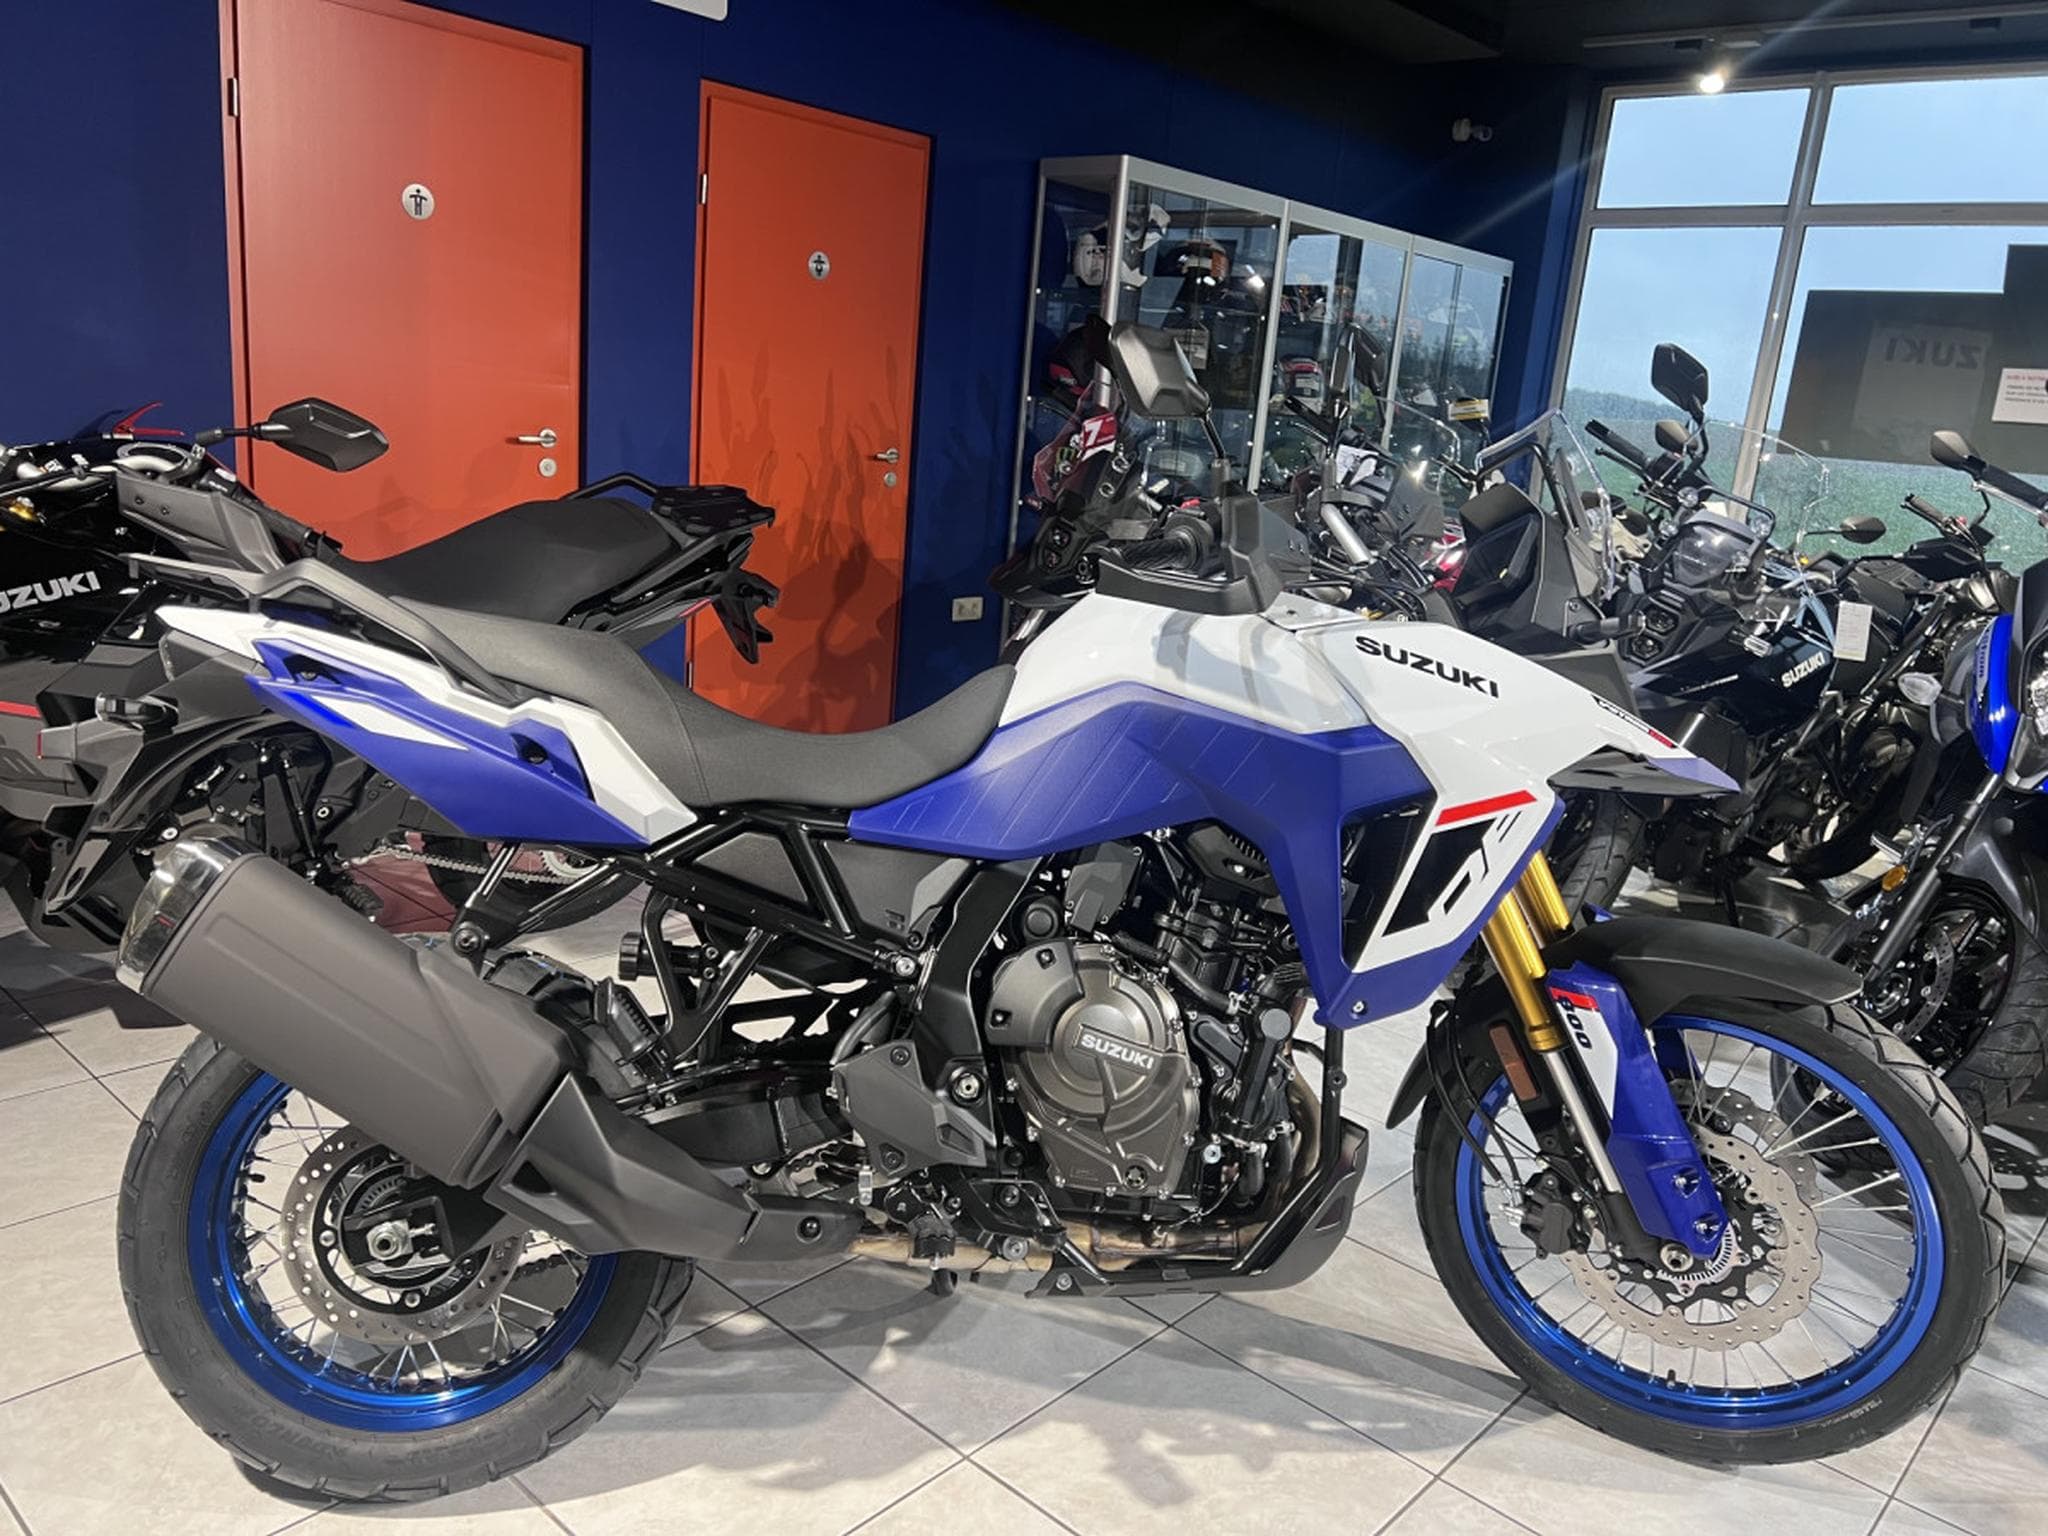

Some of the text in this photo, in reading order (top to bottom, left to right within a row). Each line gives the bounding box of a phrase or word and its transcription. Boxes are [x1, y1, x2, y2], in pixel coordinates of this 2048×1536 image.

[1355, 636, 1499, 698] SUZUKI
[1781, 651, 1826, 688] SUZUKI
[1558, 996, 1593, 1049] 800
[1081, 1033, 1154, 1069] SUZUKI
